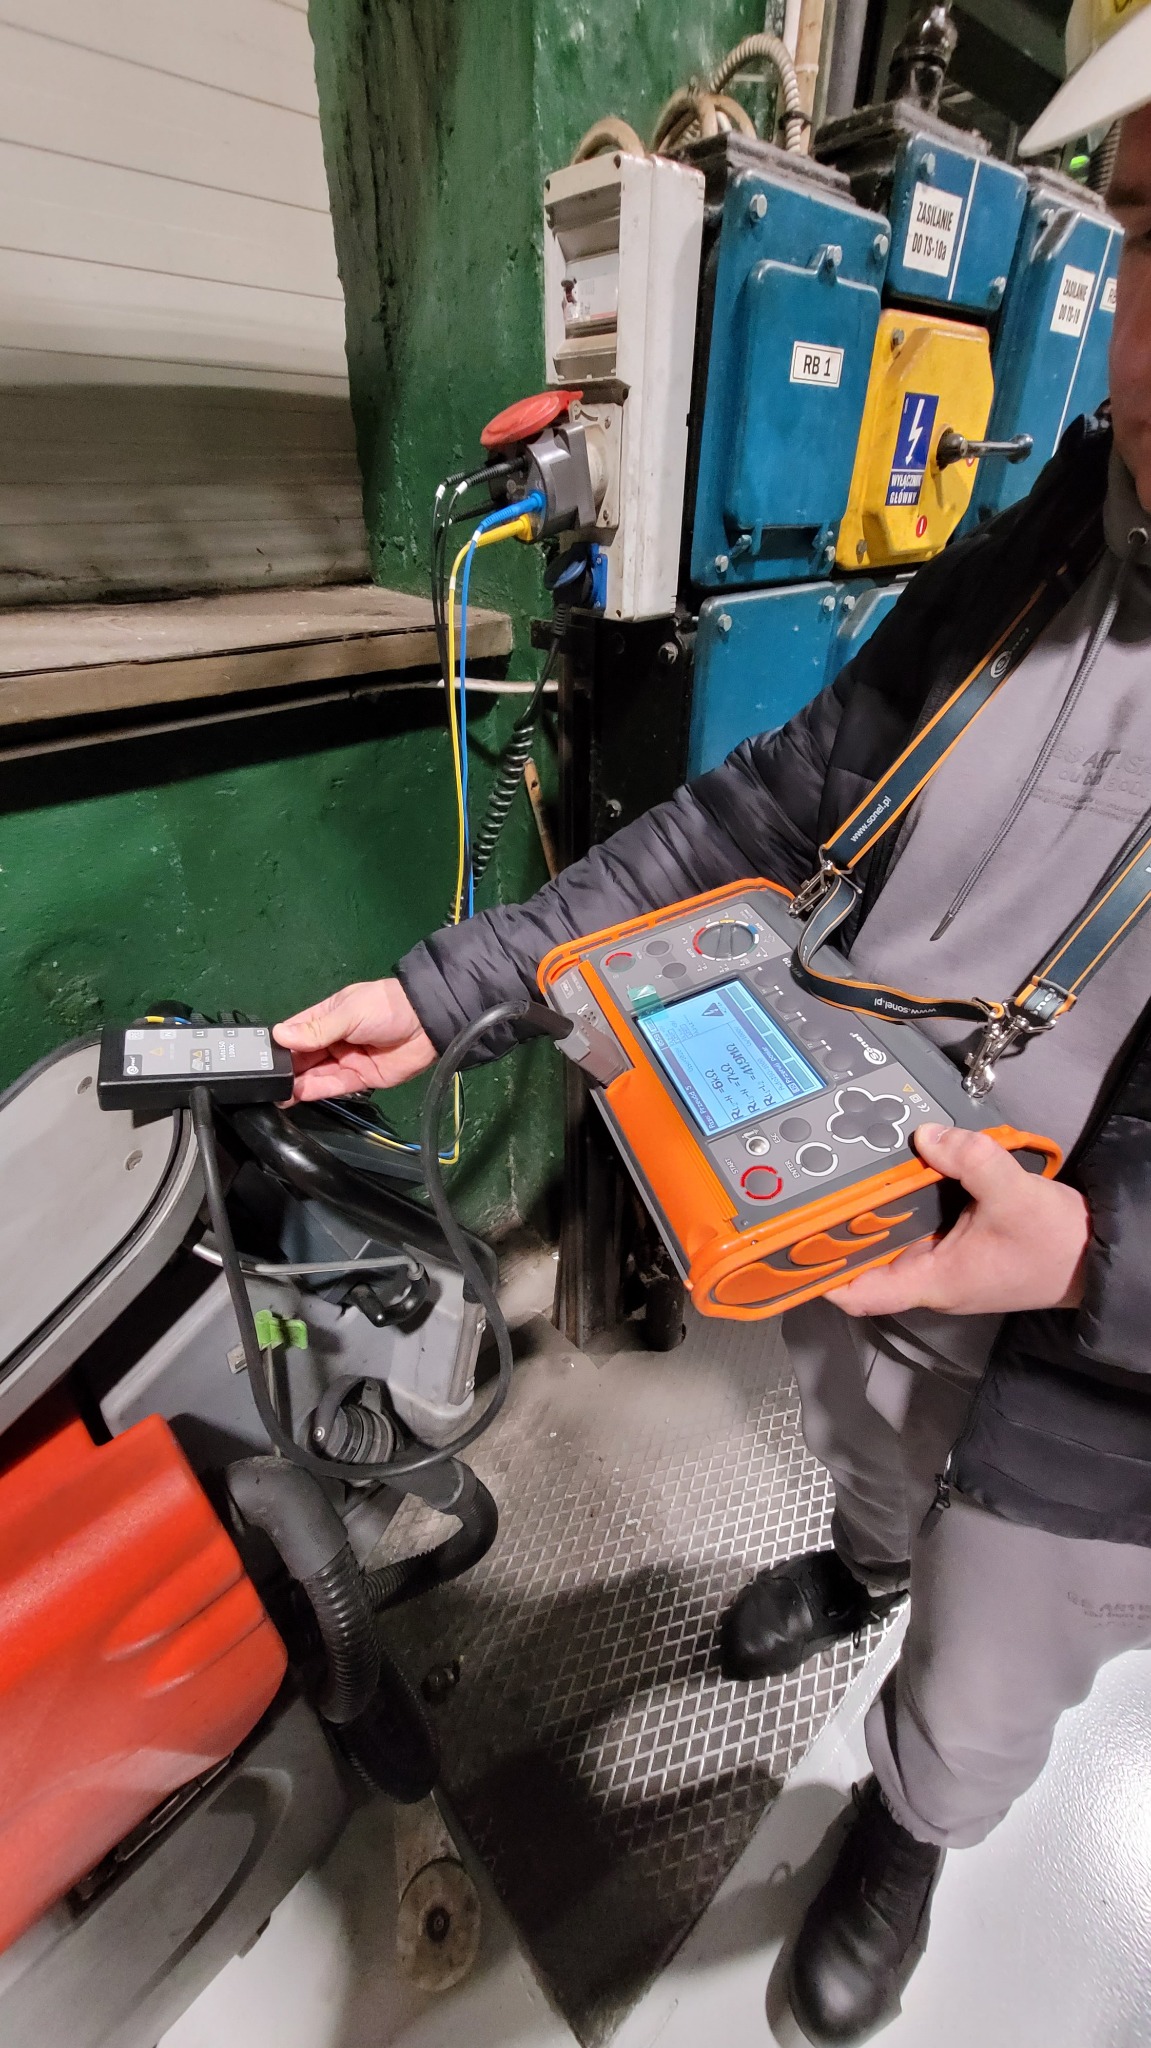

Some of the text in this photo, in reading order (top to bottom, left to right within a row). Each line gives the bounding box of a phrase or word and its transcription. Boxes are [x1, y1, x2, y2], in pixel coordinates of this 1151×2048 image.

[916, 201, 954, 232] ZASILANIE
[912, 232, 947, 261] DO TS-10a
[1062, 279, 1089, 302] ZASILANIE
[1058, 304, 1068, 321] DO
[803, 354, 831, 377] RB 1
[890, 474, 923, 489] WYŁĄCZNIK
[889, 487, 917, 504] GŁÓWNY
[849, 794, 892, 843] www.sonel.pl
[873, 996, 936, 1015] www.sonel.pl
[769, 1131, 782, 1144] ESC
[723, 1156, 739, 1175] START
[783, 1158, 801, 1179] ENTER
